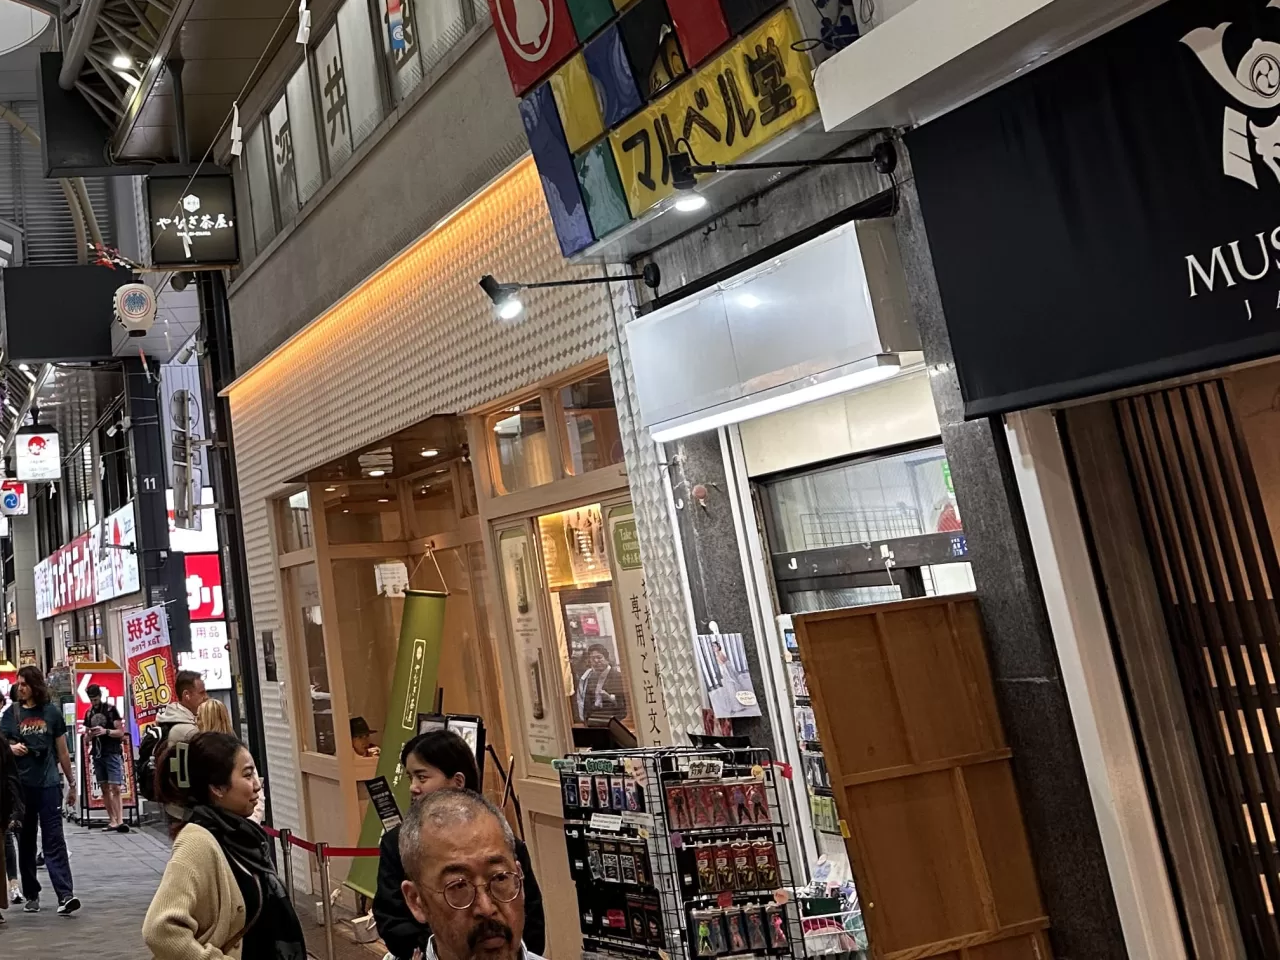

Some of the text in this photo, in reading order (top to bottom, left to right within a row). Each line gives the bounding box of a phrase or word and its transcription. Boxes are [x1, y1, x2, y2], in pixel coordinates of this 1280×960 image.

[621, 36, 797, 192] マルベル堂
[144, 477, 157, 490] 11
